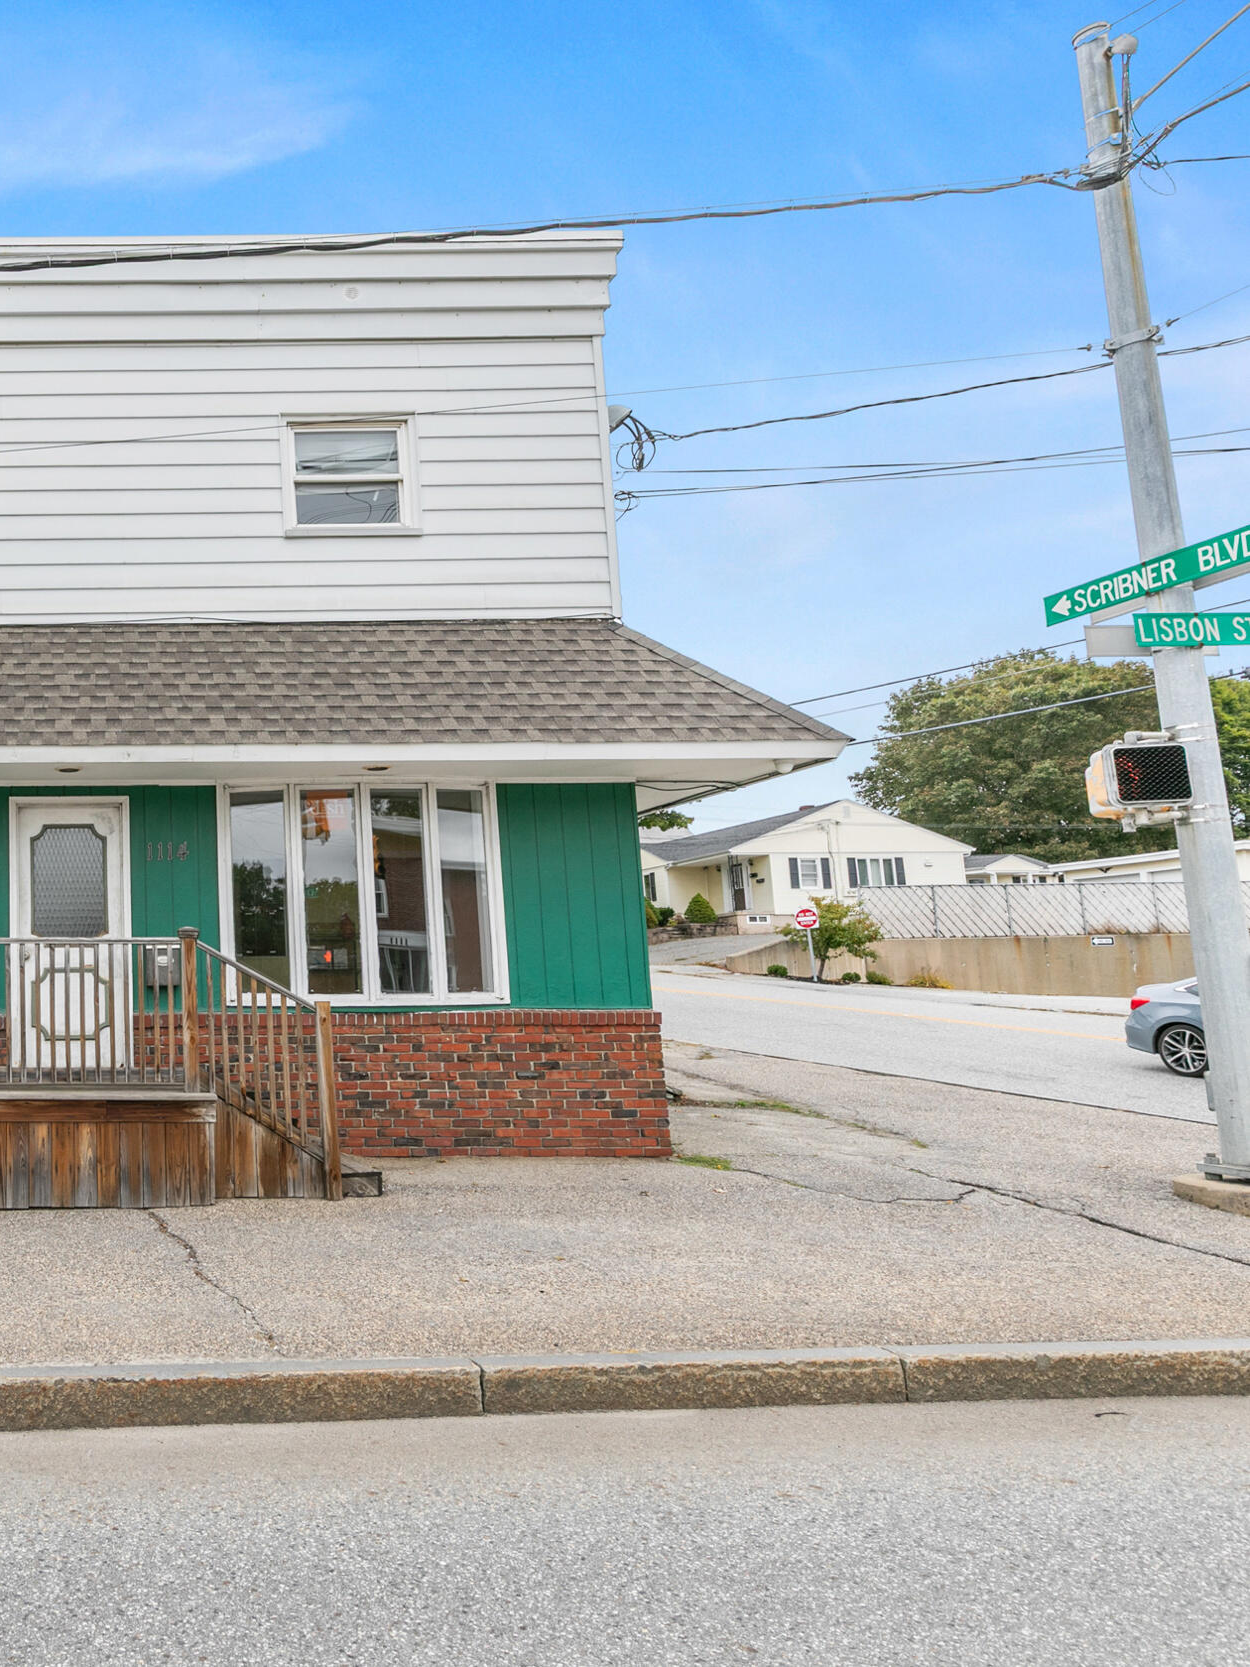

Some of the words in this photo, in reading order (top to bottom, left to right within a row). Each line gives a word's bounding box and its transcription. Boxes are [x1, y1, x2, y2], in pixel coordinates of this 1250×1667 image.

[1073, 558, 1177, 613] SCRIBNER
[1197, 529, 1250, 573] BLVD
[1137, 617, 1221, 643] LISBON
